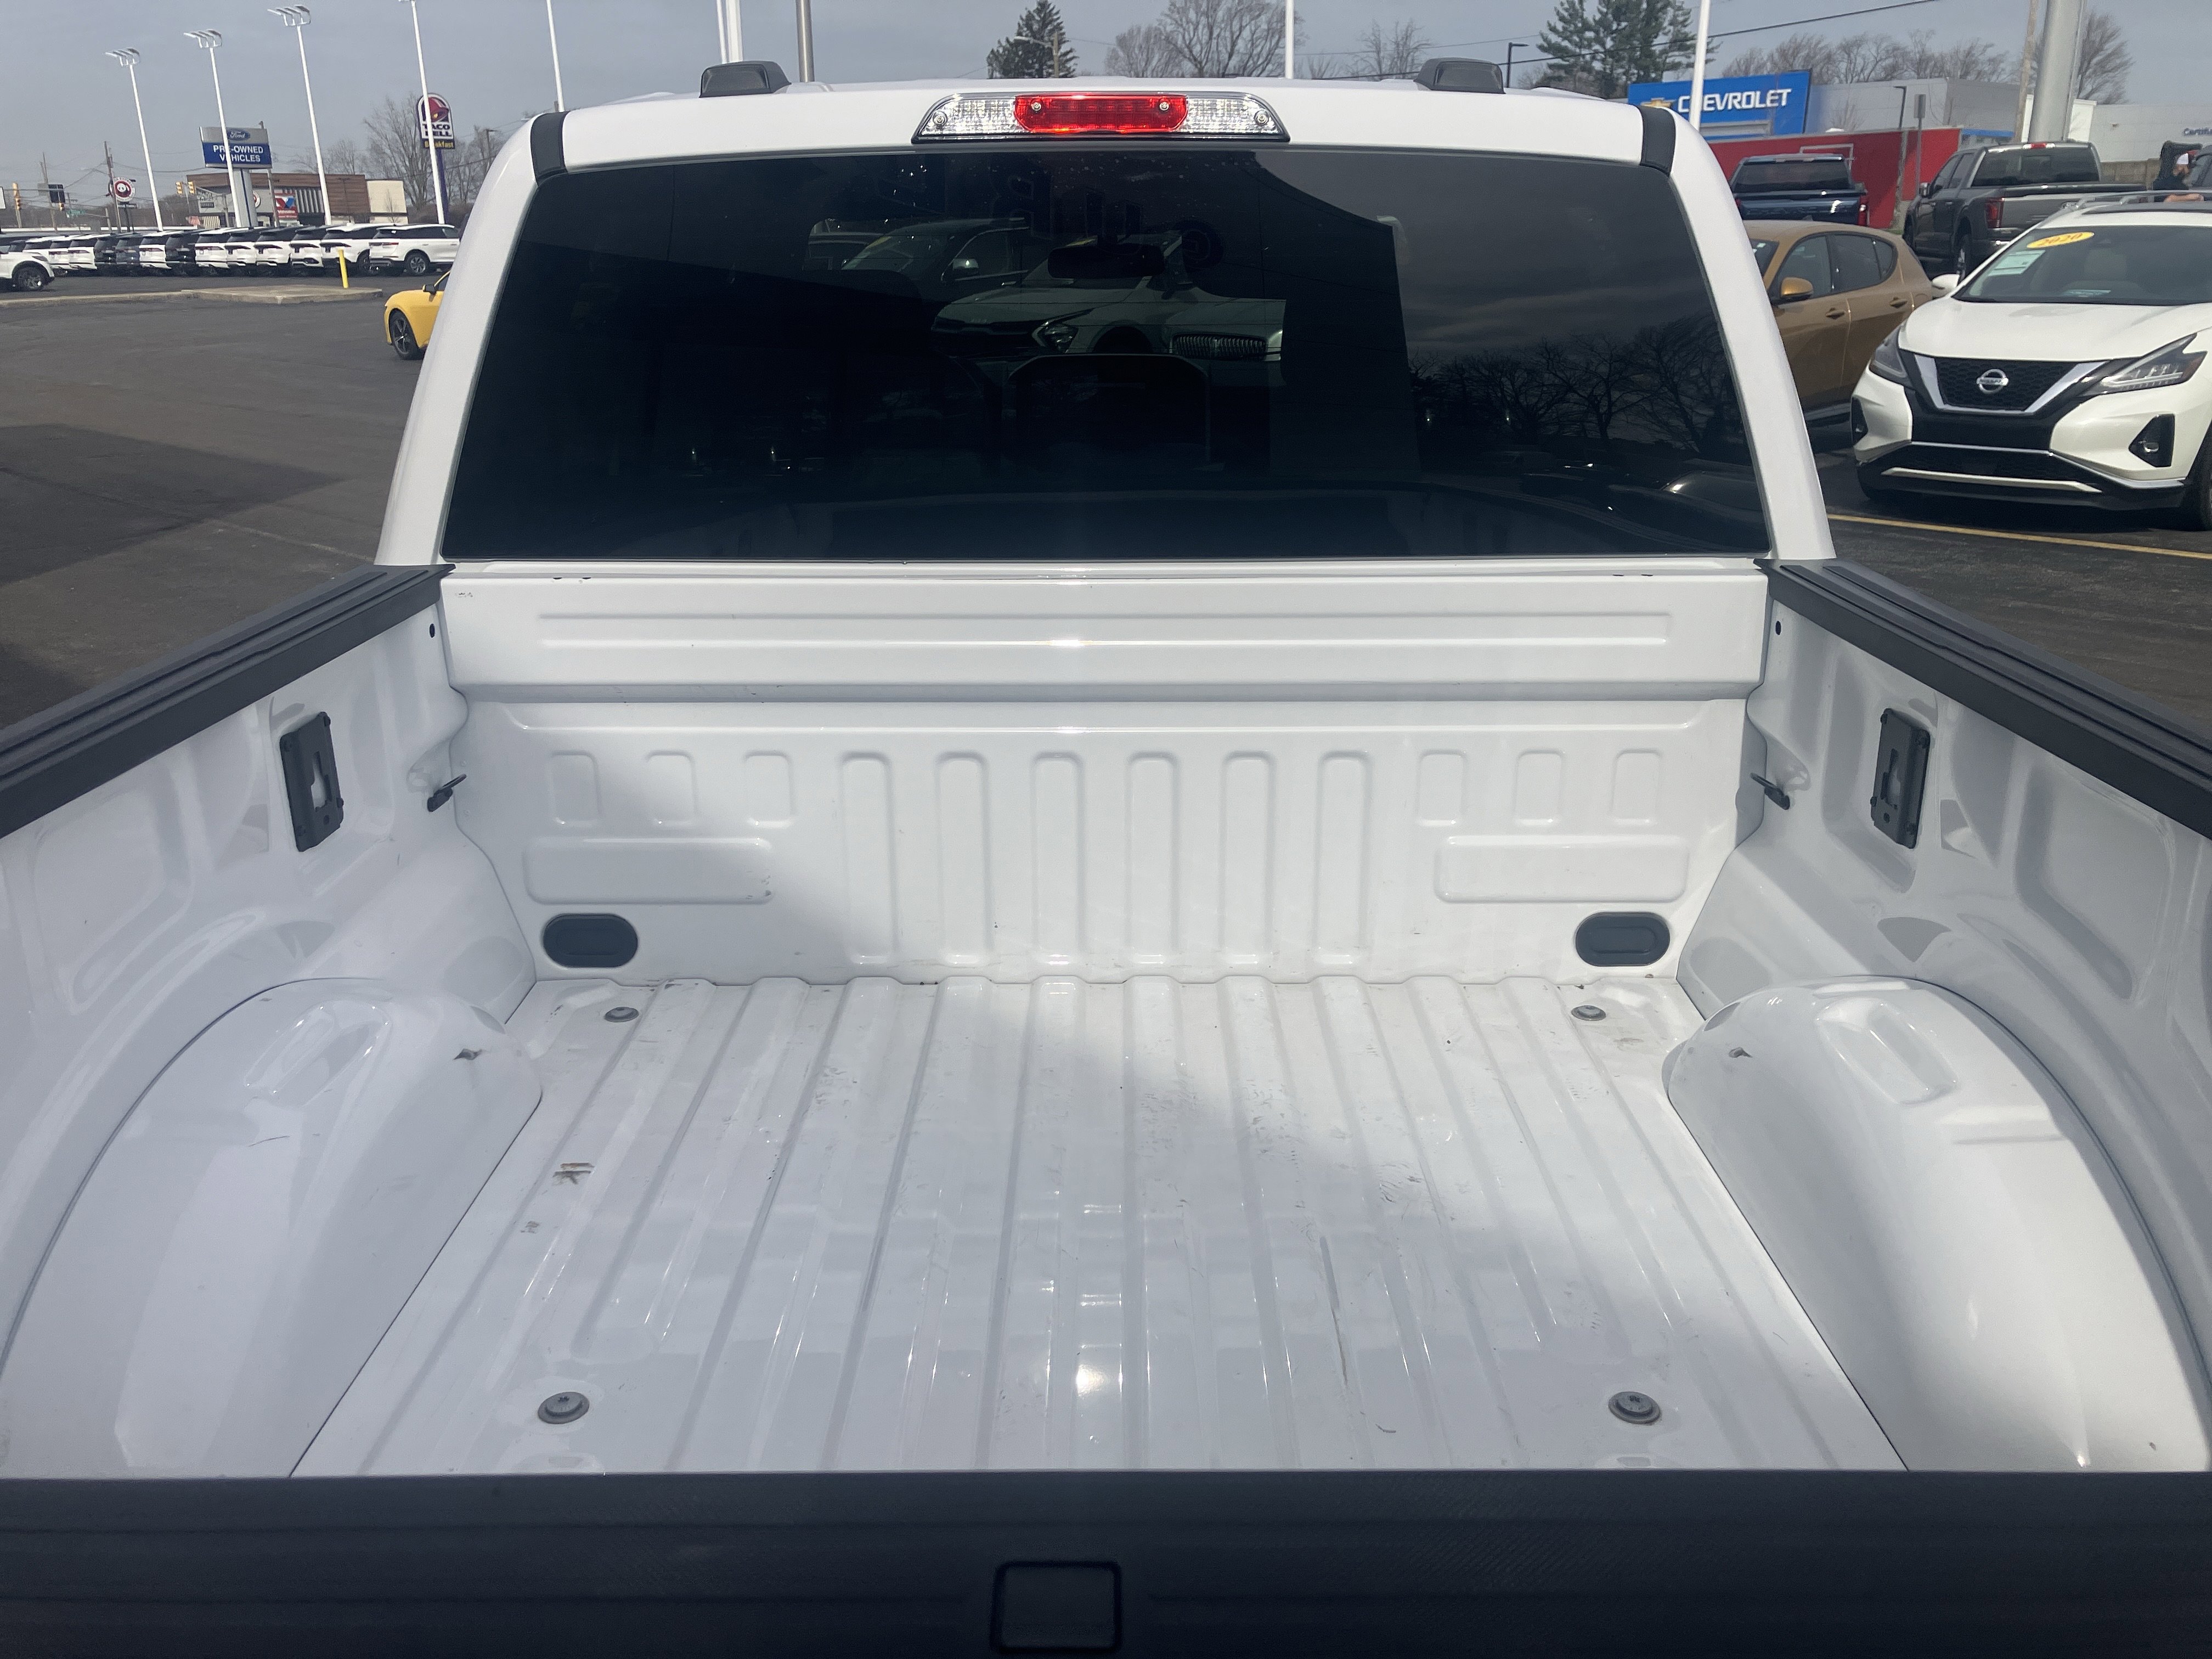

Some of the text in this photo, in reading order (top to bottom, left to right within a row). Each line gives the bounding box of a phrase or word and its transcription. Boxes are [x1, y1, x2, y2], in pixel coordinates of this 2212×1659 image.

[1678, 88, 1792, 113] CEVROLET
[213, 145, 263, 154] PR-OWNED
[219, 154, 261, 162] VHICLES
